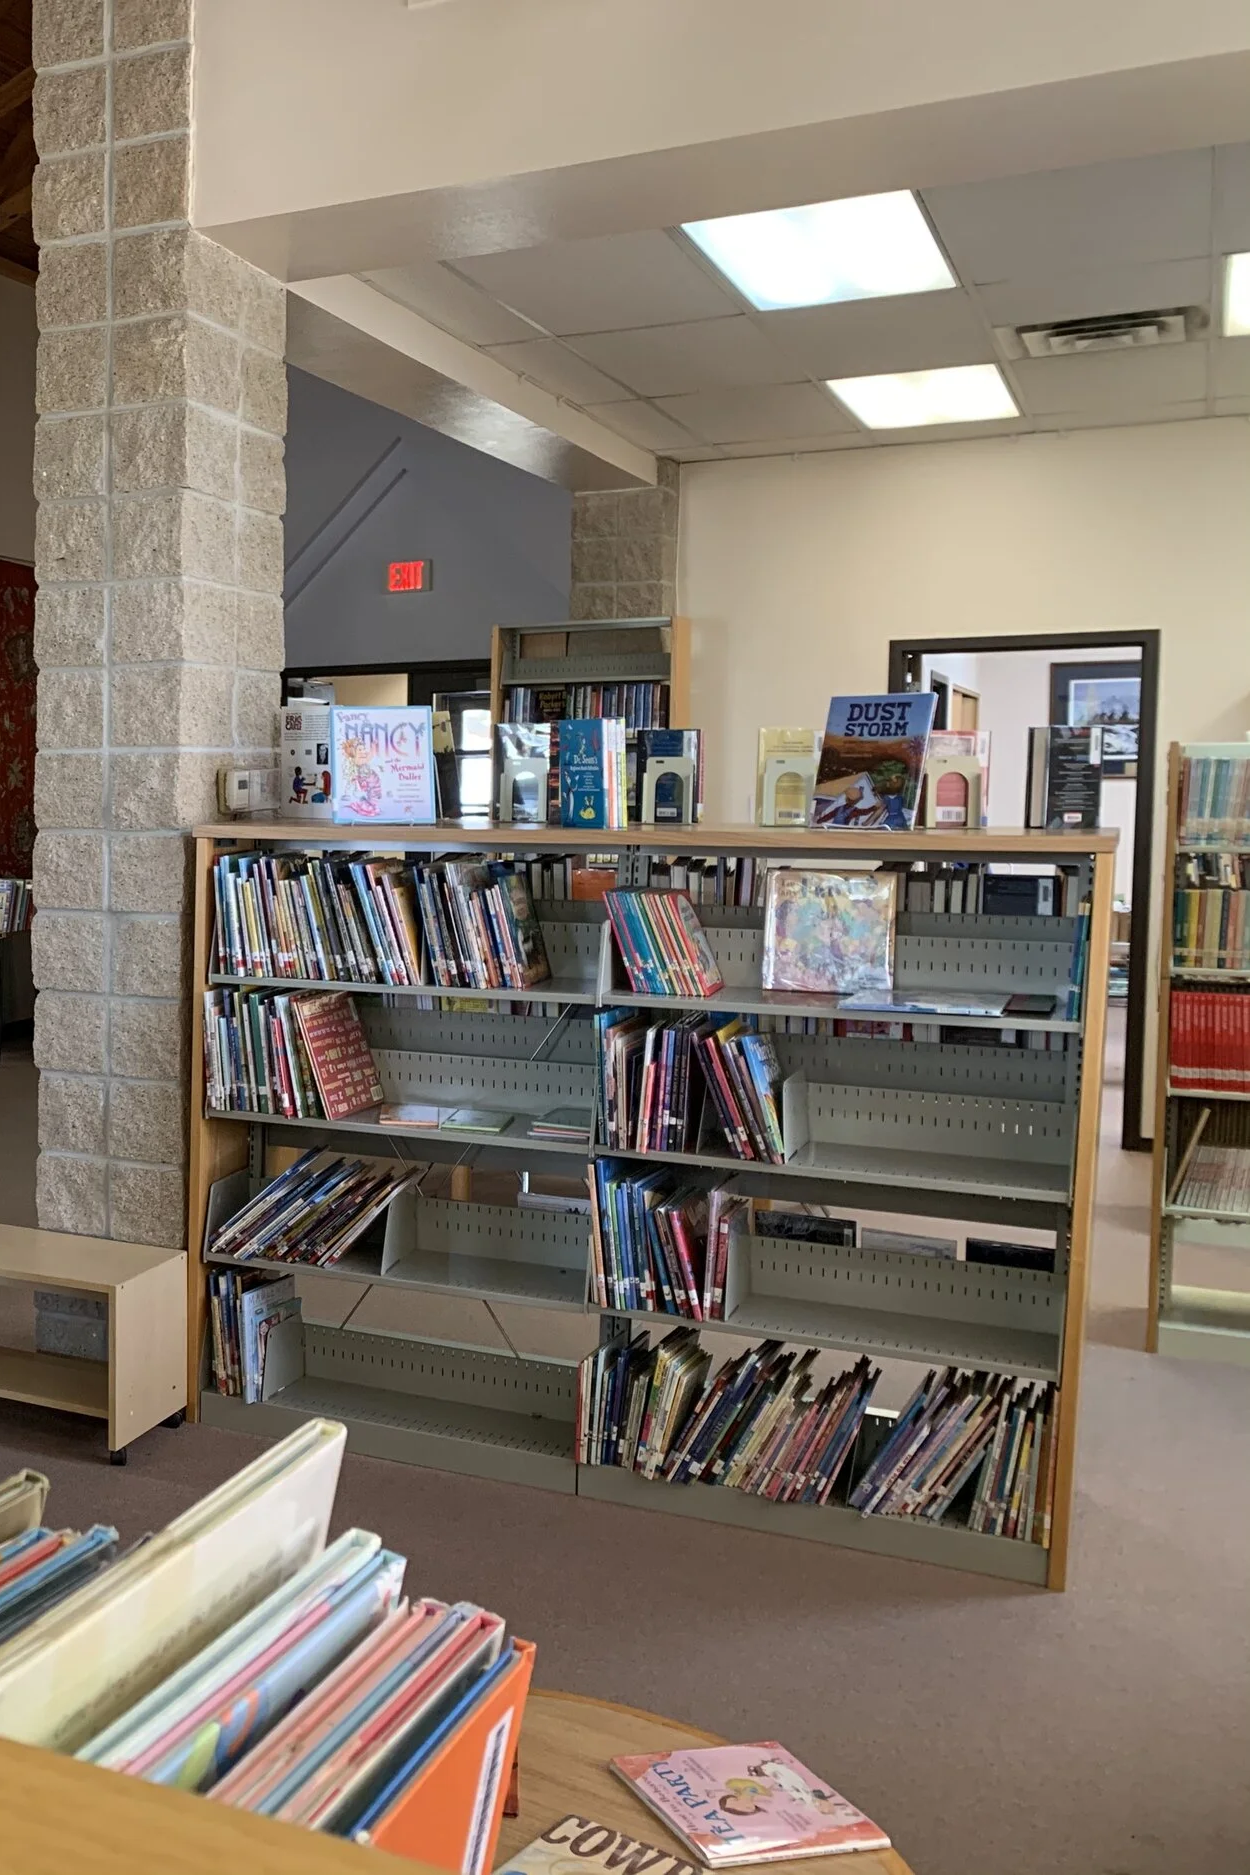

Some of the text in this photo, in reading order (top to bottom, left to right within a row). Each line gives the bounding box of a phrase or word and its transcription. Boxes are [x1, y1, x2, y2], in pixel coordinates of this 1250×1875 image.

[388, 561, 424, 591] EXIT
[336, 711, 369, 722] Fancy
[847, 702, 913, 722] DUST
[344, 721, 426, 758] NANCY
[844, 721, 910, 737] STORM
[391, 762, 425, 774] Mermaid
[652, 1761, 709, 1809] PARTY
[703, 1809, 745, 1845] TEA
